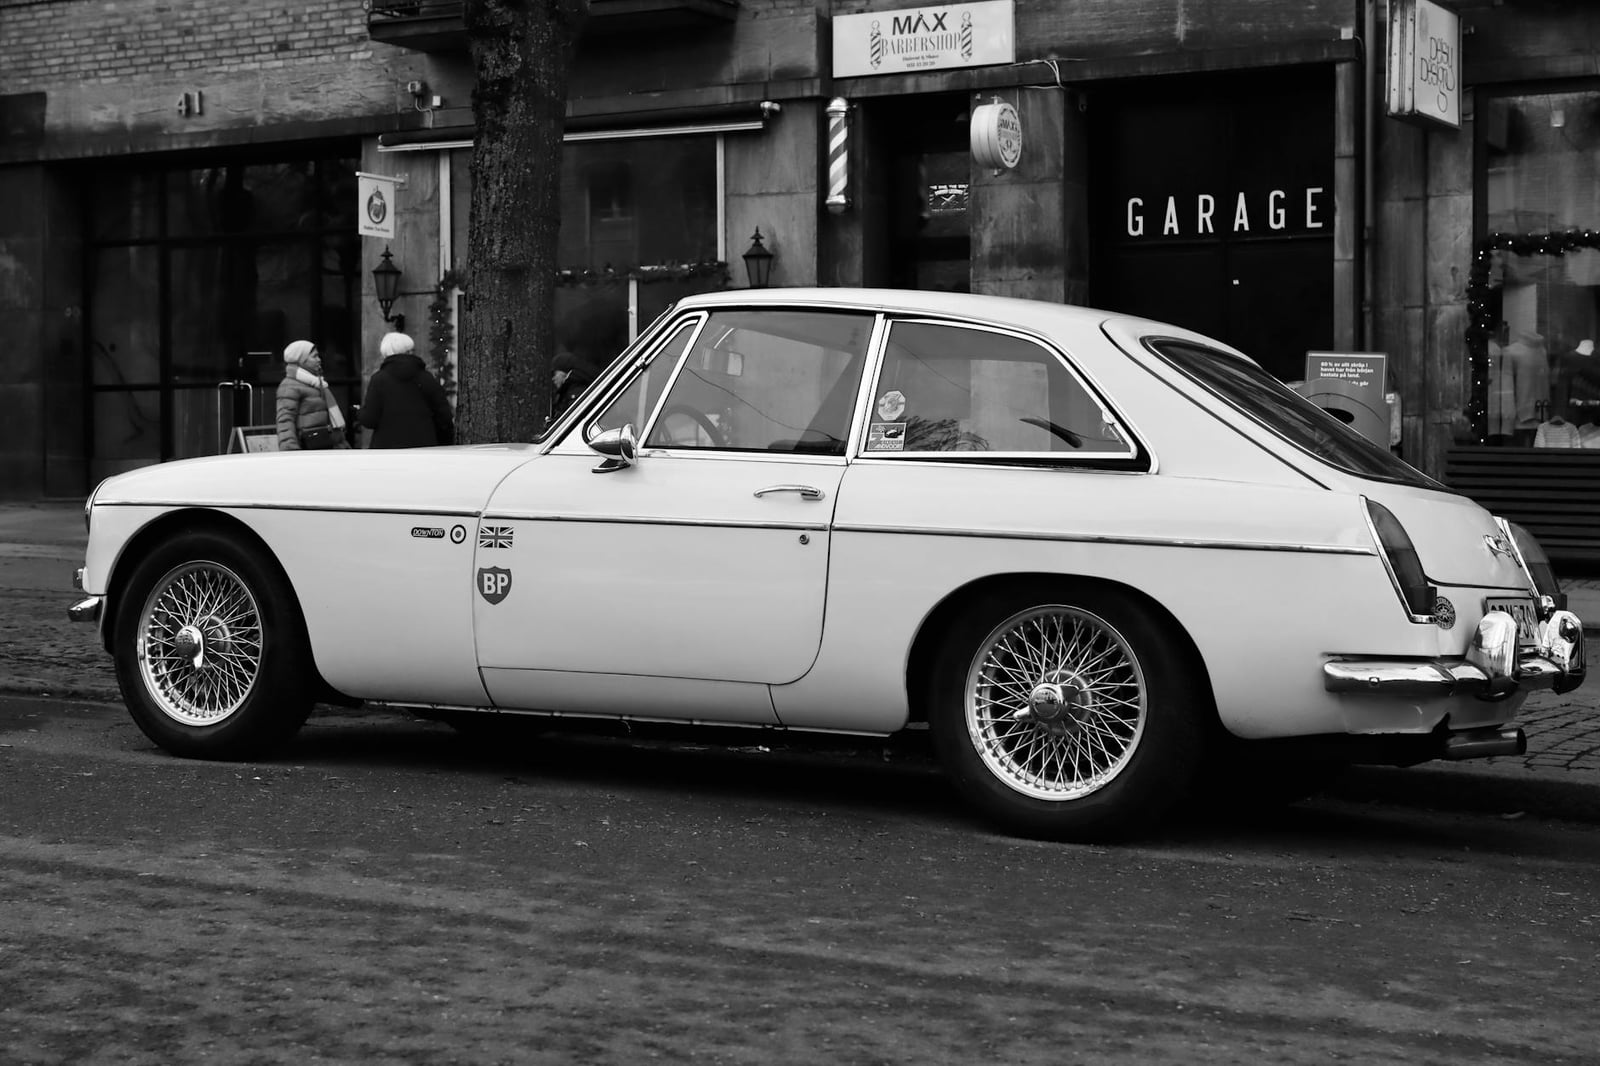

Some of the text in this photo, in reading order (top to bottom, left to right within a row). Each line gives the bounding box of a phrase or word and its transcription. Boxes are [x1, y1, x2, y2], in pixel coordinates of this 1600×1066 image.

[892, 11, 948, 36] MAX
[881, 32, 961, 57] BARBERSHOP
[176, 91, 203, 117] 41
[1127, 187, 1324, 236] GARAGE
[482, 572, 509, 595] BP
